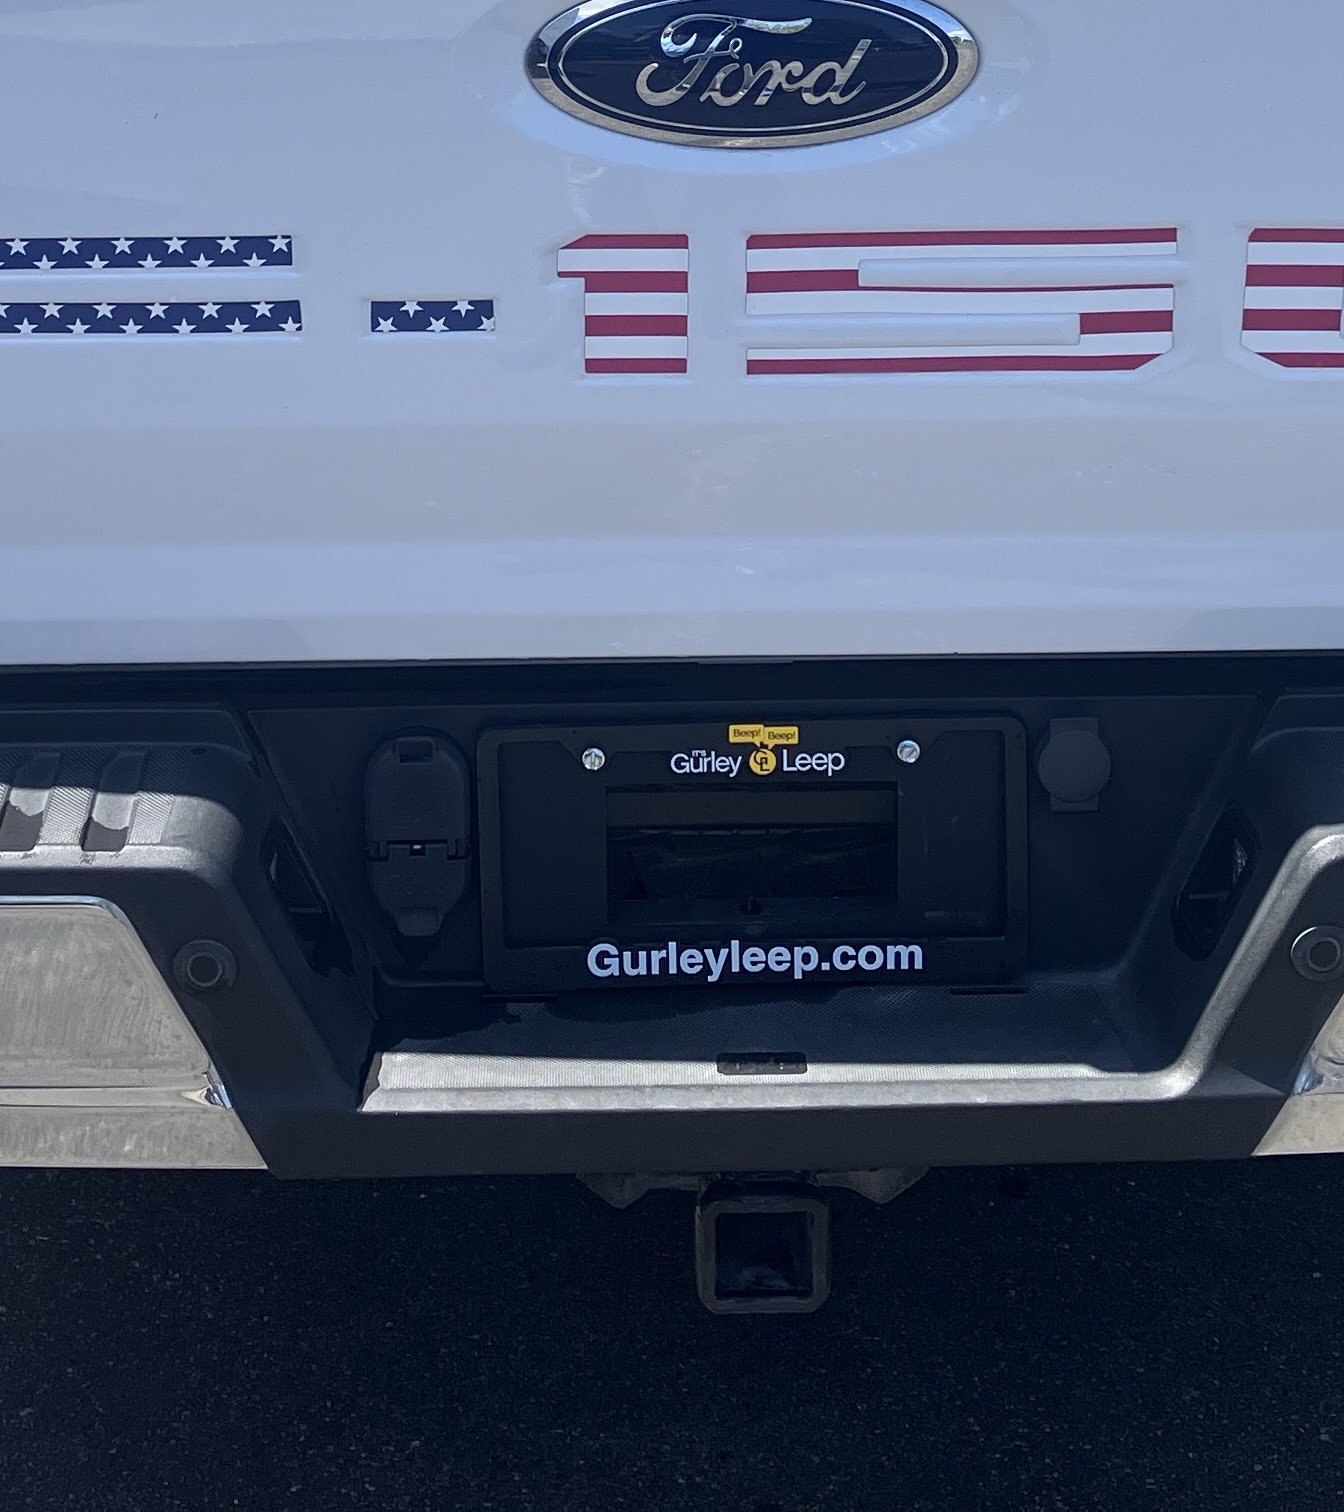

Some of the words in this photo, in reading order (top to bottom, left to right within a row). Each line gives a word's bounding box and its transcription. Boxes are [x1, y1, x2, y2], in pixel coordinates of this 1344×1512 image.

[635, 13, 873, 107] Ford
[733, 728, 761, 739] Beep!
[767, 731, 796, 742] Beep!
[670, 750, 743, 778] Gurley
[782, 748, 846, 777] Leep
[587, 940, 924, 982] Gurleyleep.com
